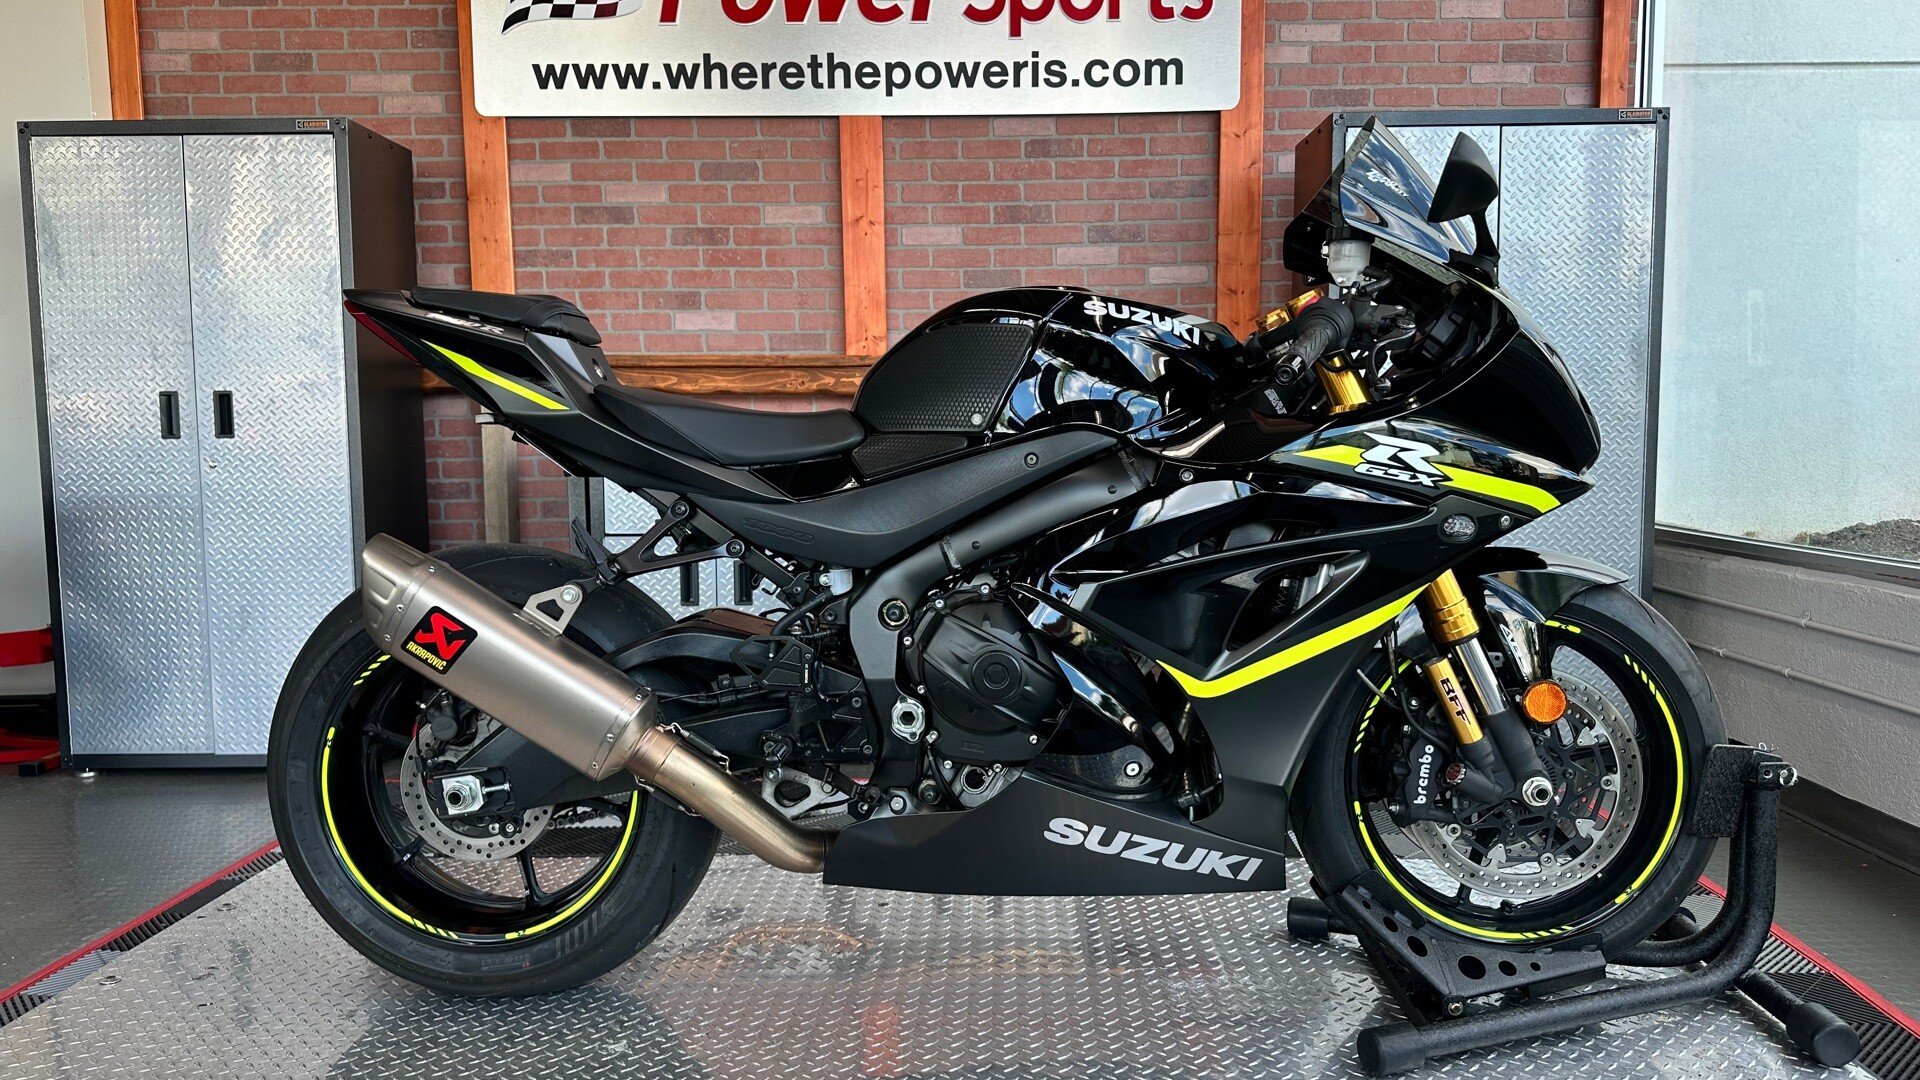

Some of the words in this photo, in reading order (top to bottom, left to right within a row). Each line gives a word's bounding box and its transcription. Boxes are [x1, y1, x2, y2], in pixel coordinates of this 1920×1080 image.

[532, 51, 1185, 97] www.wherethepoweris.com
[1083, 299, 1200, 345] SUZUKI
[1353, 462, 1445, 488] GSX
[405, 641, 447, 671] AKRAPOVIC
[1438, 677, 1472, 726] BFF
[1413, 744, 1435, 805] brembo
[1044, 817, 1263, 881] SUZUKI
